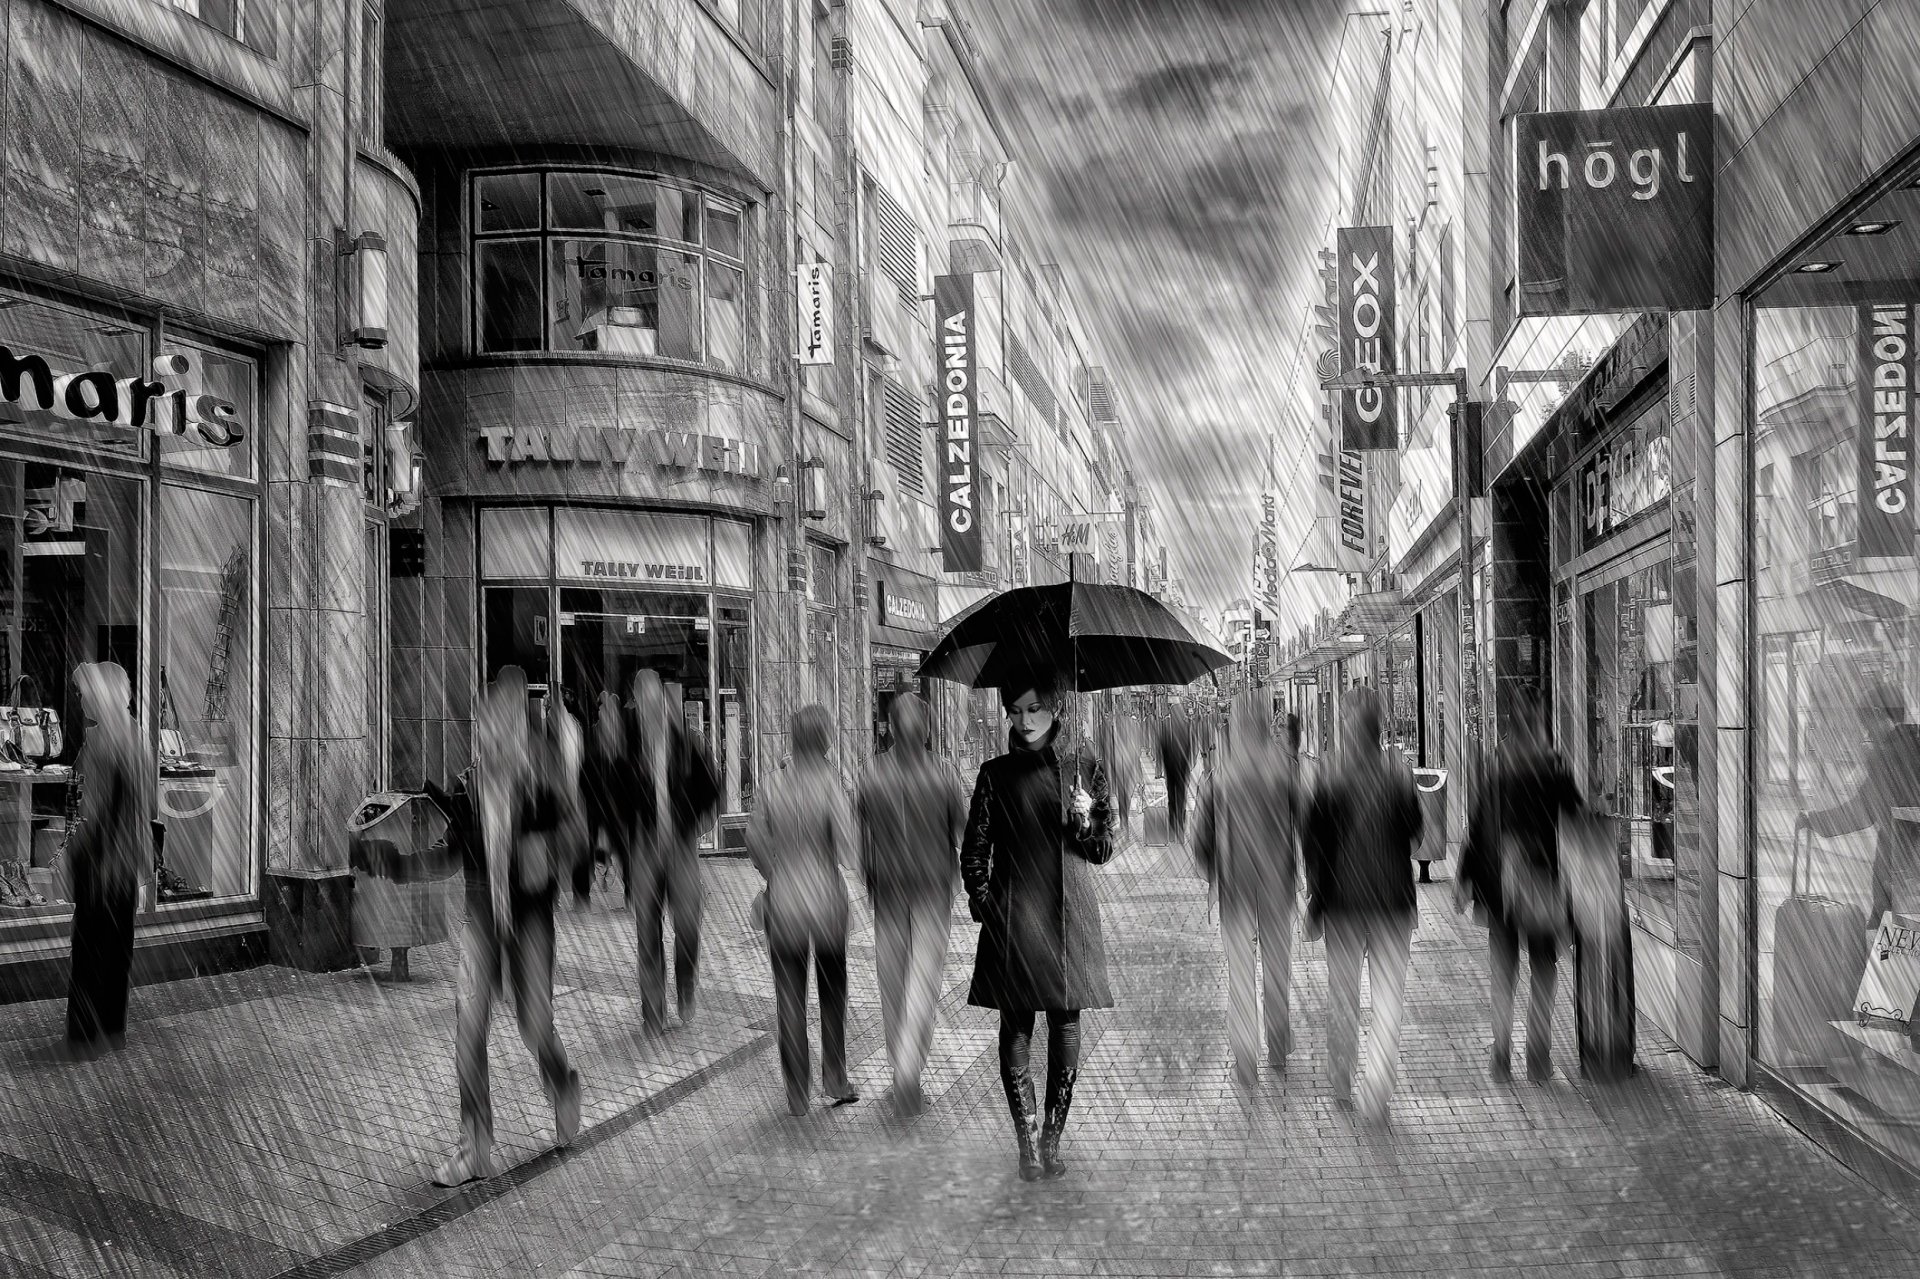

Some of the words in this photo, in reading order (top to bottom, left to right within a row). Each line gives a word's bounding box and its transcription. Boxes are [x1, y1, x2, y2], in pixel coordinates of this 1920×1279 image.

[808, 267, 821, 359] tamaris
[1352, 250, 1383, 424] GEOX
[480, 427, 637, 463] TALLY
[944, 310, 972, 533] CALZEDONIA
[1061, 523, 1090, 546] H&M
[582, 561, 639, 578] TALLY
